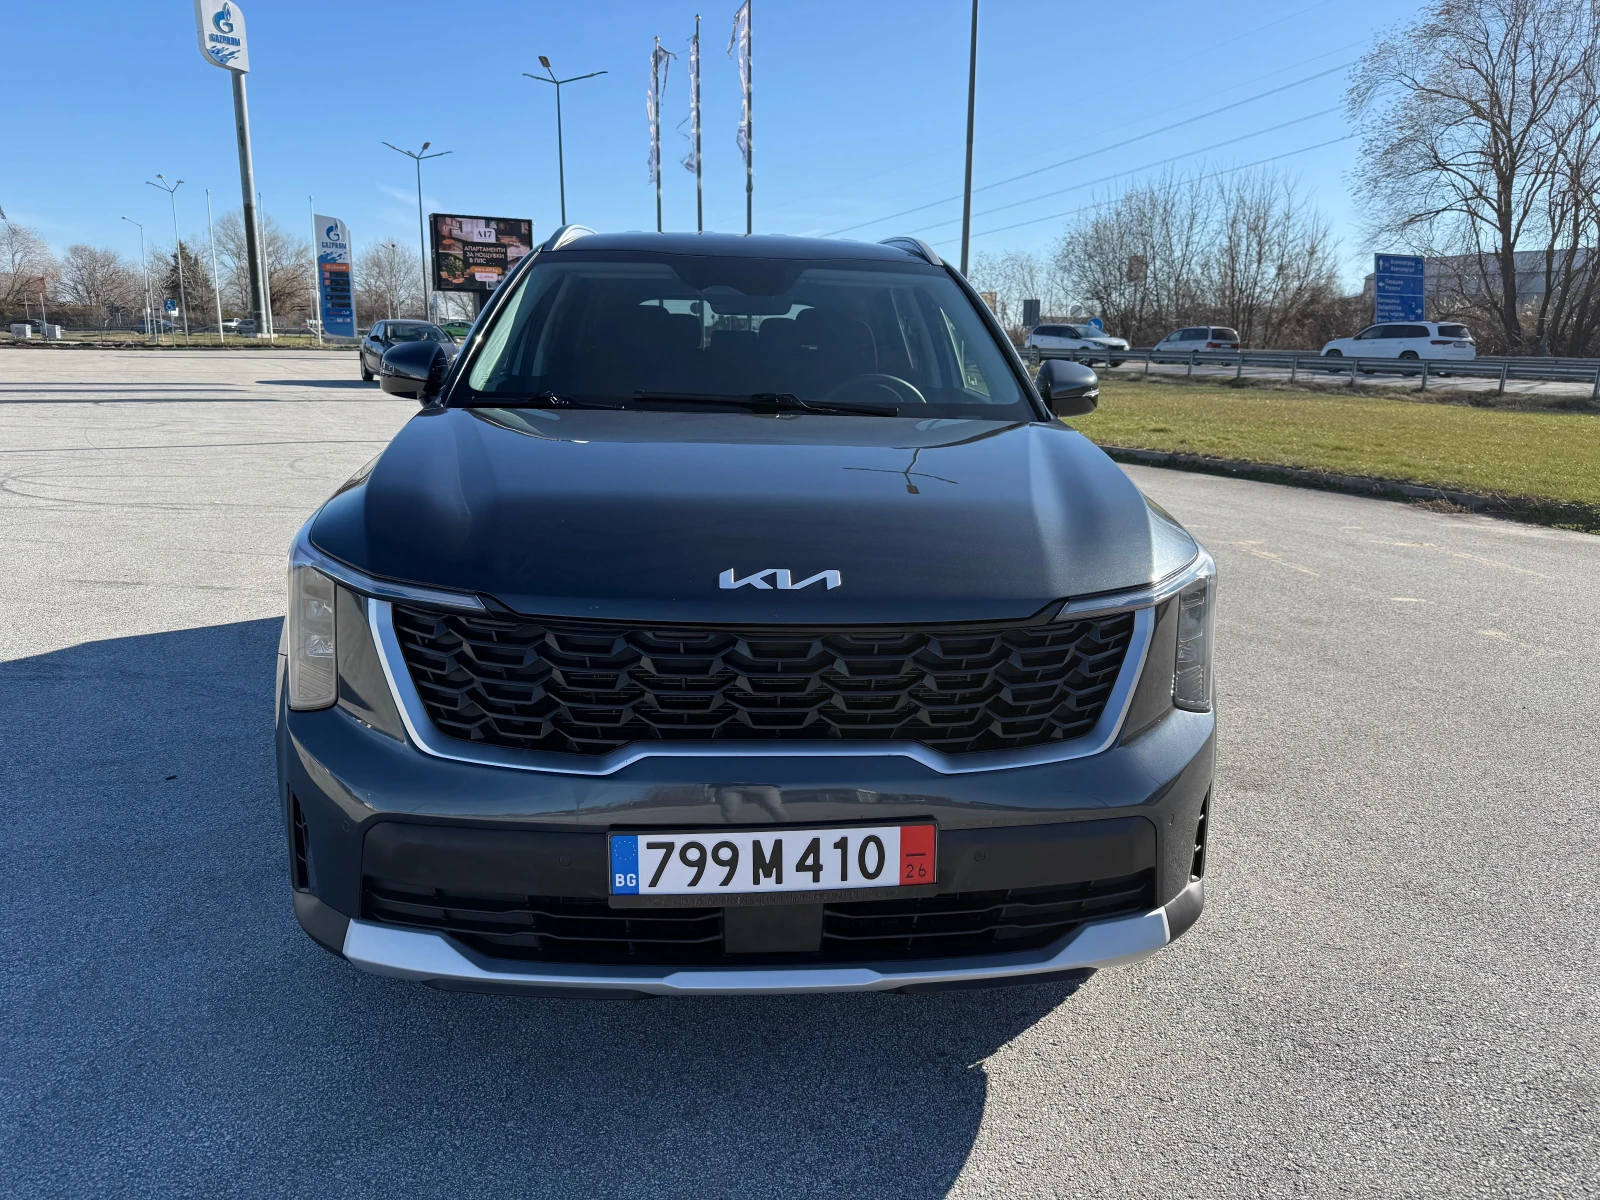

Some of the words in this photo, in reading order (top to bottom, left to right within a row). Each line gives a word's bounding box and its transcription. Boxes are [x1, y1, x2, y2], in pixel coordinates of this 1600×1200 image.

[209, 33, 241, 46] GAZPROM
[321, 241, 347, 250] GAZPROM
[464, 245, 506, 253] АПАРТАМЕНТИ
[905, 863, 927, 879] 26
[615, 873, 637, 887] BG
